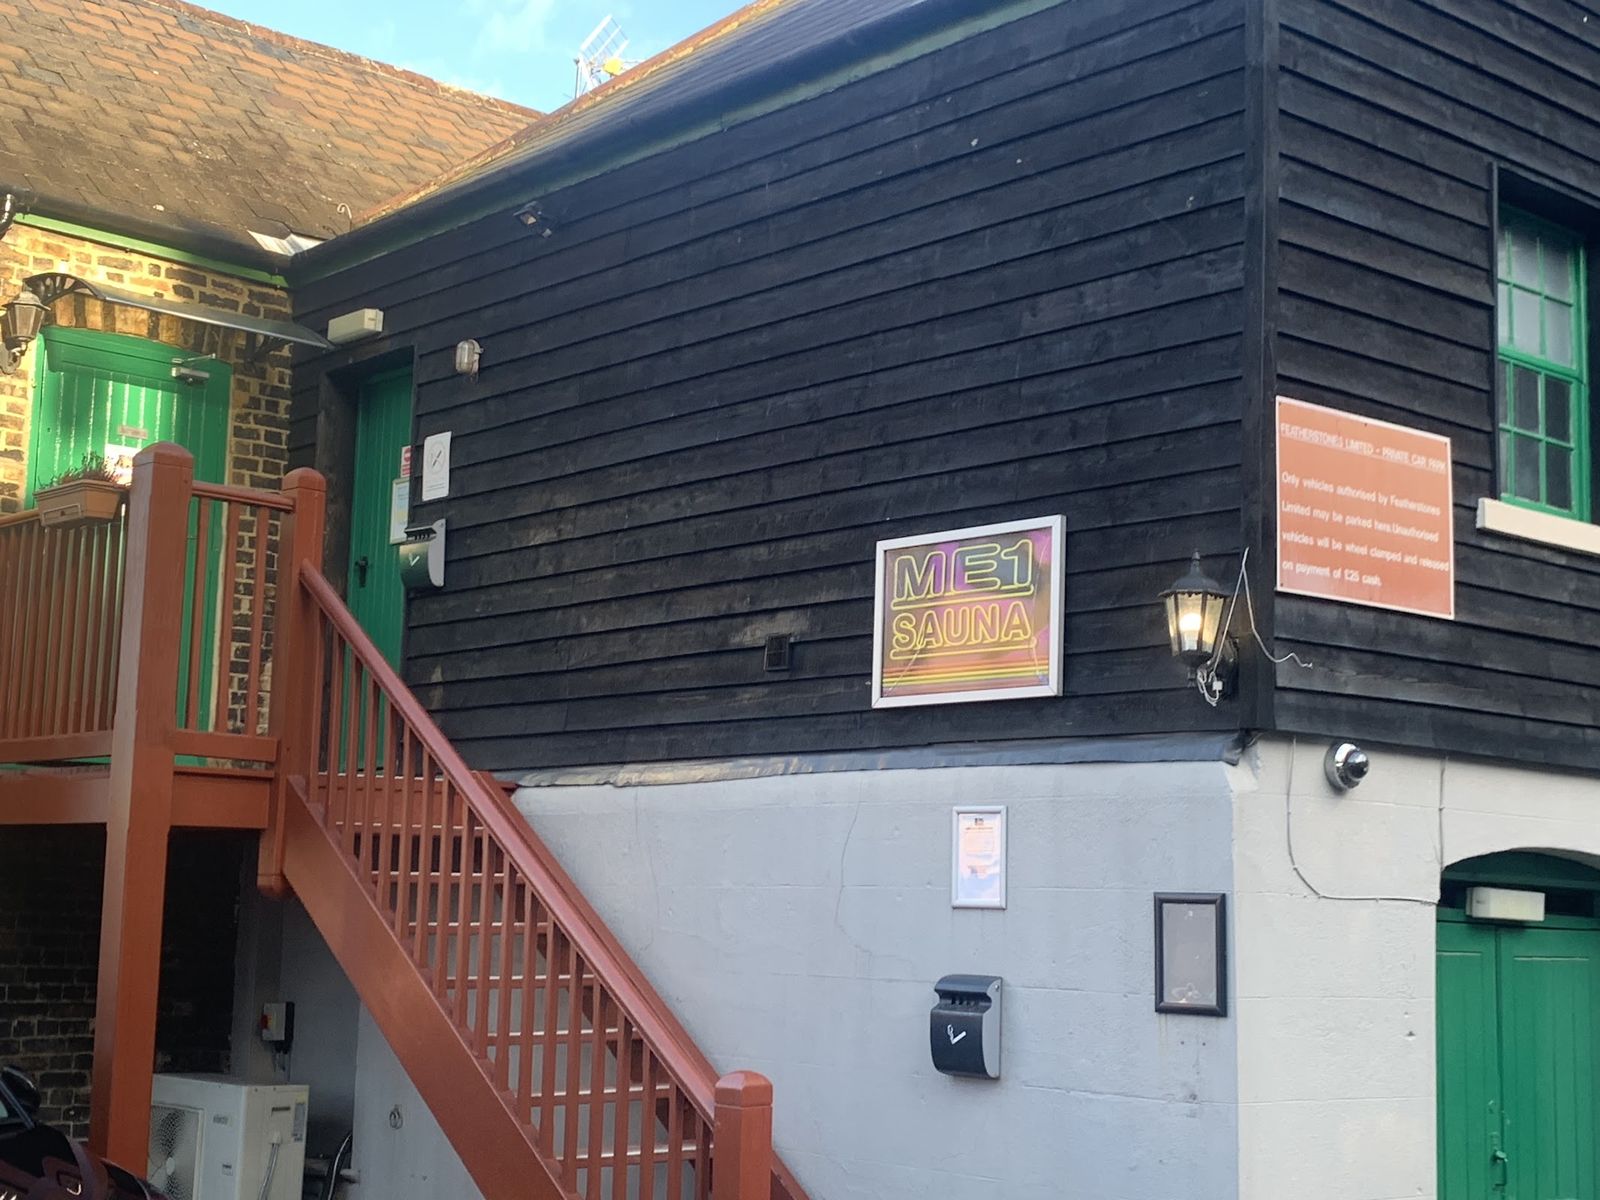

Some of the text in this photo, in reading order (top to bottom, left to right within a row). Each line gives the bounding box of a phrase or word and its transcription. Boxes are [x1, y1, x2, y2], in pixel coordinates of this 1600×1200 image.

[1345, 438, 1374, 455] LIMITED
[1382, 446, 1409, 463] PRIVATE
[1411, 453, 1425, 467] CAR
[1428, 457, 1446, 472] PARK
[1282, 471, 1441, 515] Only vehicles authorised by Featherstones
[1282, 500, 1311, 516] Limited
[1312, 508, 1329, 522] may
[1332, 510, 1343, 523] be
[1345, 515, 1372, 528] parked
[1392, 522, 1439, 543] Unauthorised
[894, 539, 1032, 600] ME1
[1282, 531, 1449, 571] vehicles will be wheel clamped and released
[1282, 560, 1294, 570] on
[1296, 562, 1330, 577] payment
[1332, 568, 1341, 579] of
[892, 601, 1032, 650] SAUNA
